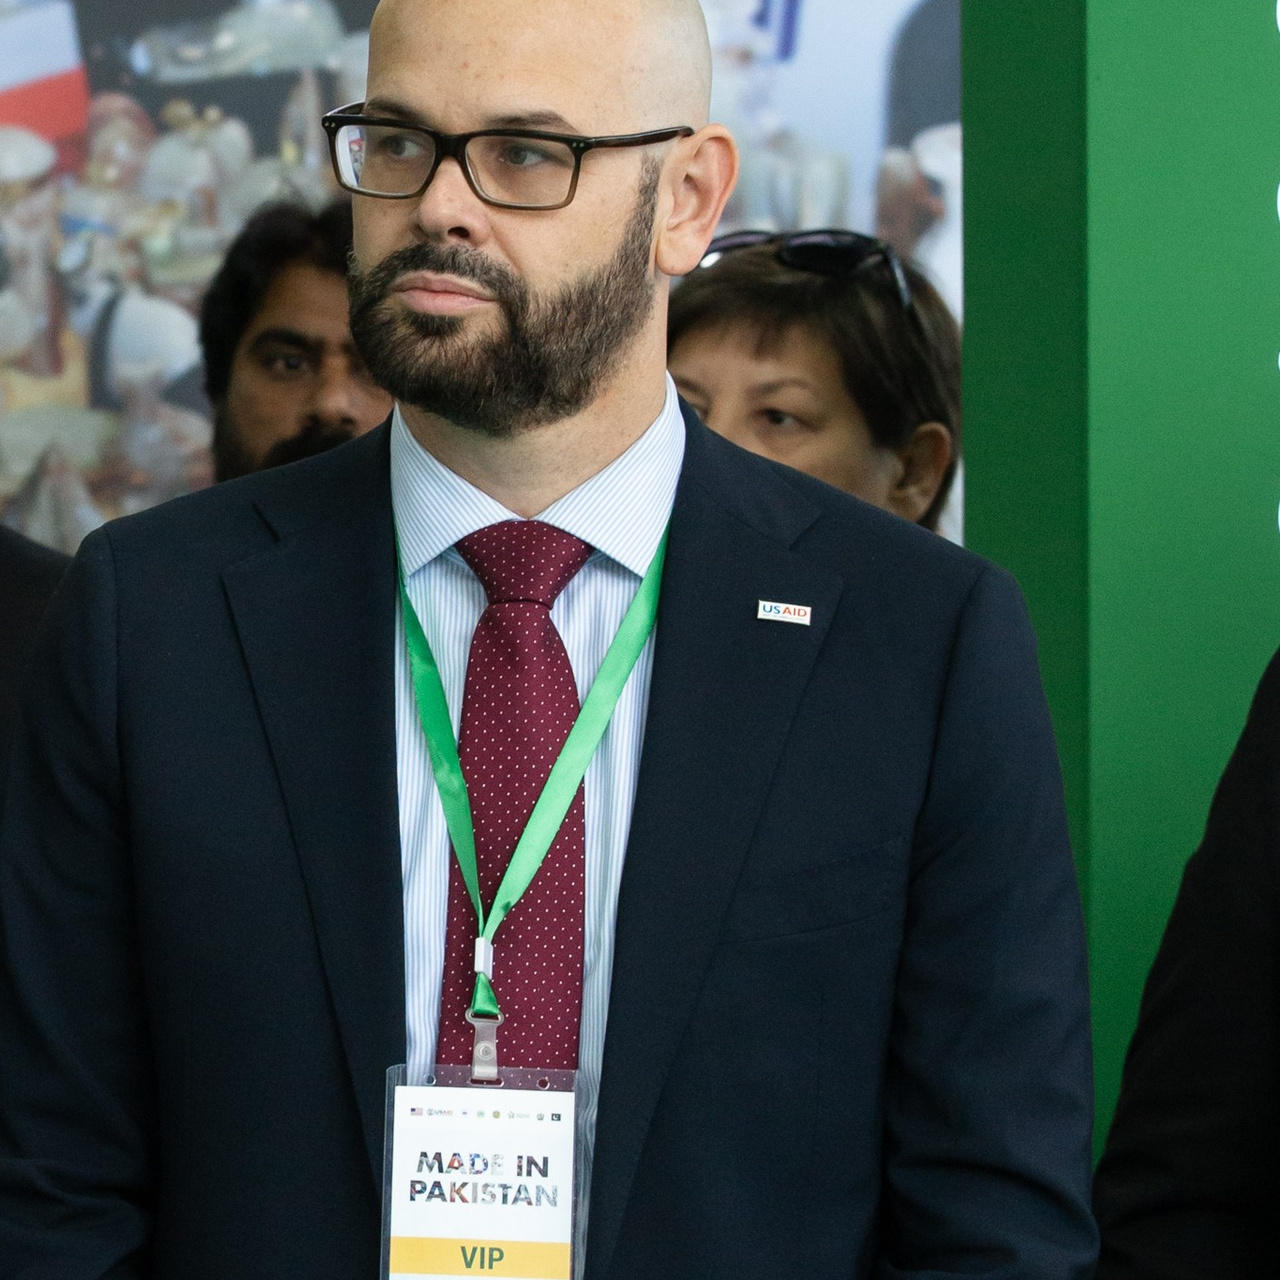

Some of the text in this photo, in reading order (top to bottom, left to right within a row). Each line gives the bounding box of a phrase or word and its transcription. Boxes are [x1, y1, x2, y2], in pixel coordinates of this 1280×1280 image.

[762, 604, 807, 617] USAID
[416, 1151, 549, 1178] MADE IN
[409, 1180, 558, 1207] PAKISTAN
[460, 1246, 505, 1269] VIP
